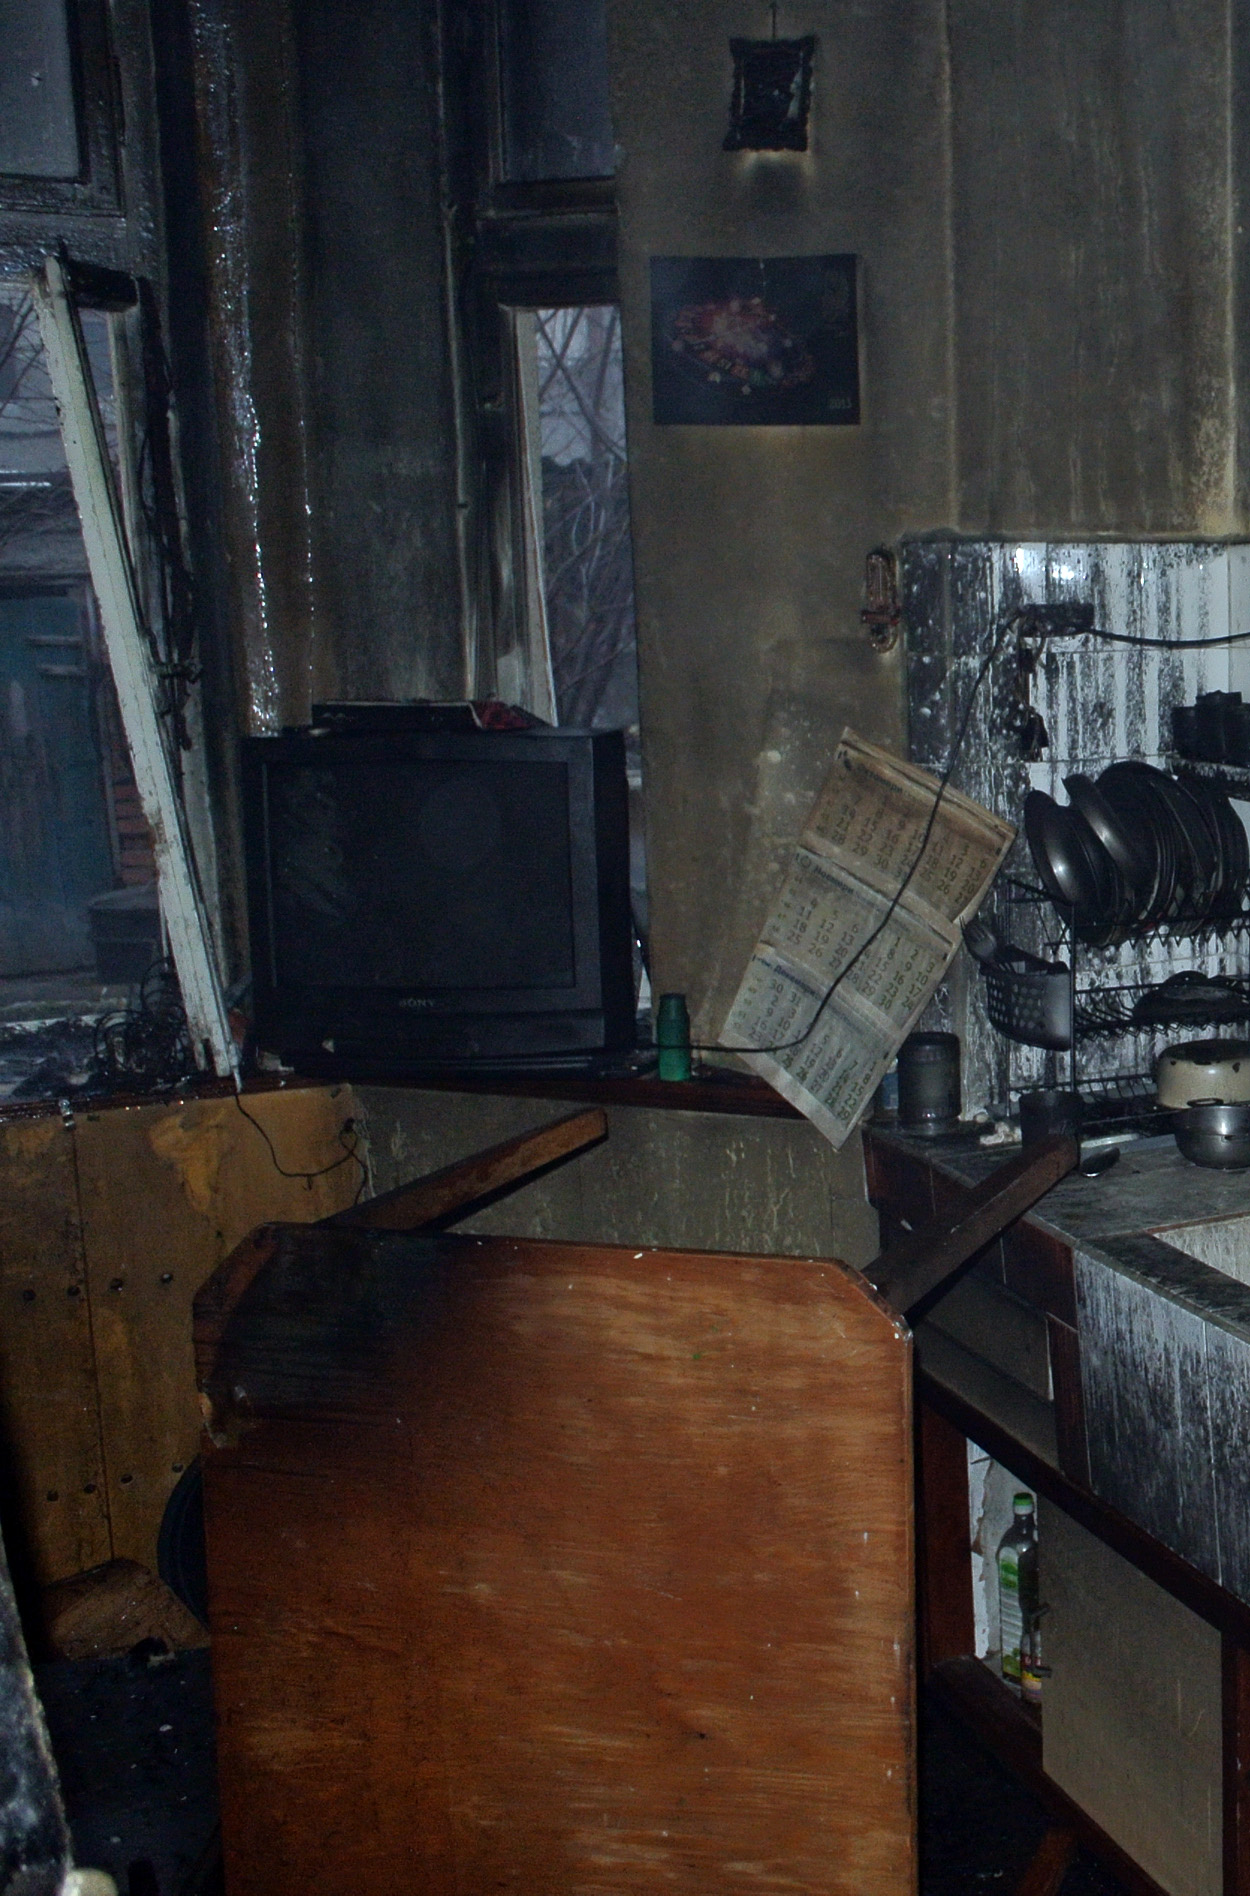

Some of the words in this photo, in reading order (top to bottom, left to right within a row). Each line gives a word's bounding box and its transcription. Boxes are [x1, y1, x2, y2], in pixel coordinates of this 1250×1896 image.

[831, 830, 846, 843] 28
[852, 842, 868, 856] 29
[874, 856, 889, 869] 30
[837, 817, 850, 830] 21
[858, 830, 873, 843] 22
[879, 842, 894, 855] 23
[919, 868, 933, 880] 25
[935, 880, 952, 894] 26
[862, 817, 878, 831] 15
[884, 830, 900, 843] 16
[925, 855, 939, 868] 18
[942, 867, 958, 880] 19
[960, 879, 976, 893] 20
[931, 843, 945, 854] 11
[948, 855, 964, 868] 12
[967, 868, 982, 880] 13
[979, 858, 988, 867] 6
[787, 929, 801, 945] 25
[808, 942, 823, 958] 26
[828, 956, 841, 970] 27
[846, 969, 860, 983] 28
[861, 982, 875, 996] 29
[878, 995, 892, 1009] 30
[793, 918, 807, 932] 18
[814, 930, 829, 946] 19
[835, 944, 848, 957] 20
[868, 970, 882, 984] 22
[884, 982, 899, 997] 23
[901, 996, 915, 1010] 24
[799, 906, 811, 919] 11
[820, 918, 833, 932] 12
[840, 931, 854, 945] 13
[875, 958, 888, 971] 15
[892, 971, 906, 985] 16
[907, 983, 921, 997] 17
[851, 923, 860, 933] 6
[886, 948, 896, 960] 8
[903, 961, 912, 972] 9
[914, 972, 928, 985] 10
[910, 949, 918, 959] 2
[925, 962, 935, 973] 3
[769, 978, 784, 994] 30
[789, 992, 802, 1007] 31
[749, 1027, 762, 1043] 23
[782, 1053, 794, 1069] 25
[796, 1066, 809, 1083] 26
[811, 1081, 822, 1094] 27
[825, 1093, 837, 1107] 28
[837, 1106, 850, 1122] 29
[755, 1016, 768, 1031] 16
[773, 1029, 785, 1043] 17
[804, 1055, 816, 1070] 19
[832, 1081, 843, 1095] 21
[845, 1094, 858, 1109] 22
[765, 1008, 774, 1019] 9
[778, 1016, 791, 1032] 10
[811, 1044, 822, 1057] 12
[852, 1082, 864, 1097] 15
[788, 1008, 797, 1020] 3
[863, 1073, 871, 1085] 8
